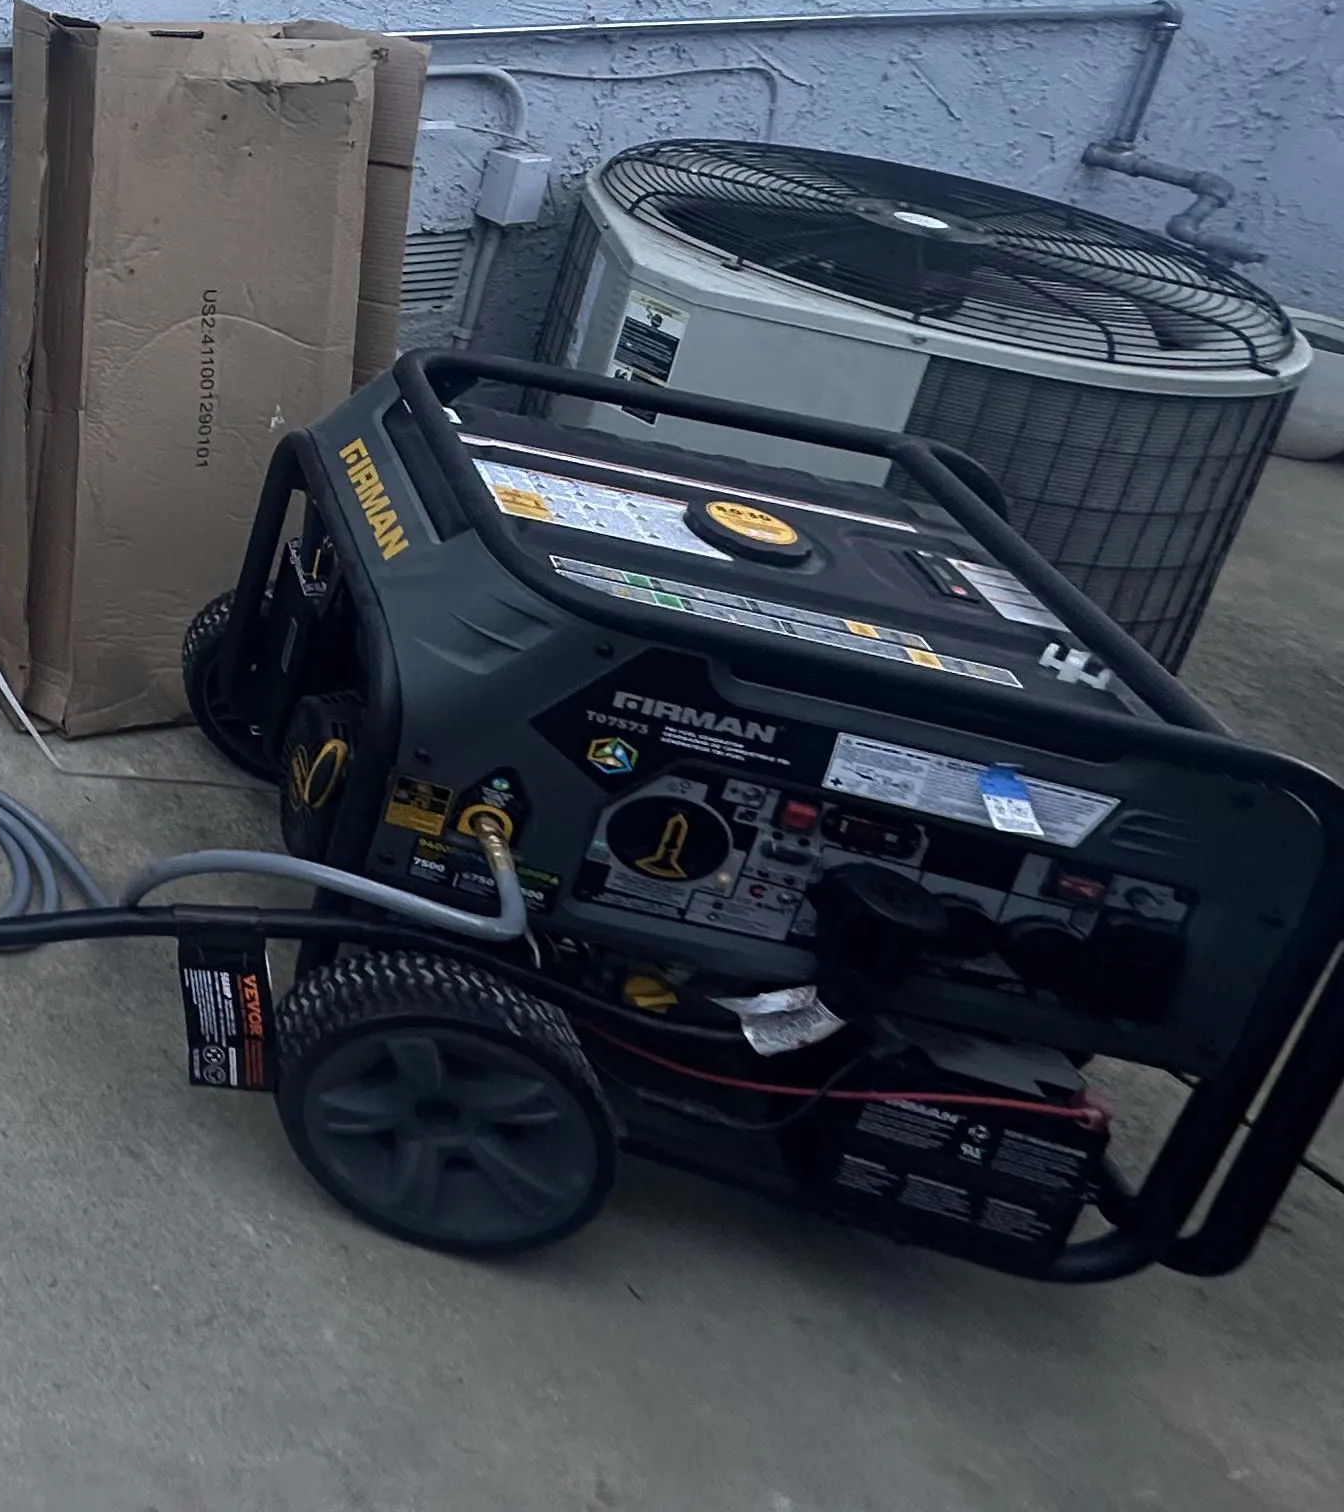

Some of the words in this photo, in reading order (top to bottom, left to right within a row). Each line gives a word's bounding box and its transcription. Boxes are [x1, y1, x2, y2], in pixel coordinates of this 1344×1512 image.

[338, 437, 409, 561] FIRMAN
[612, 691, 777, 744] FIRMAN
[243, 973, 265, 1037] VEVOR
